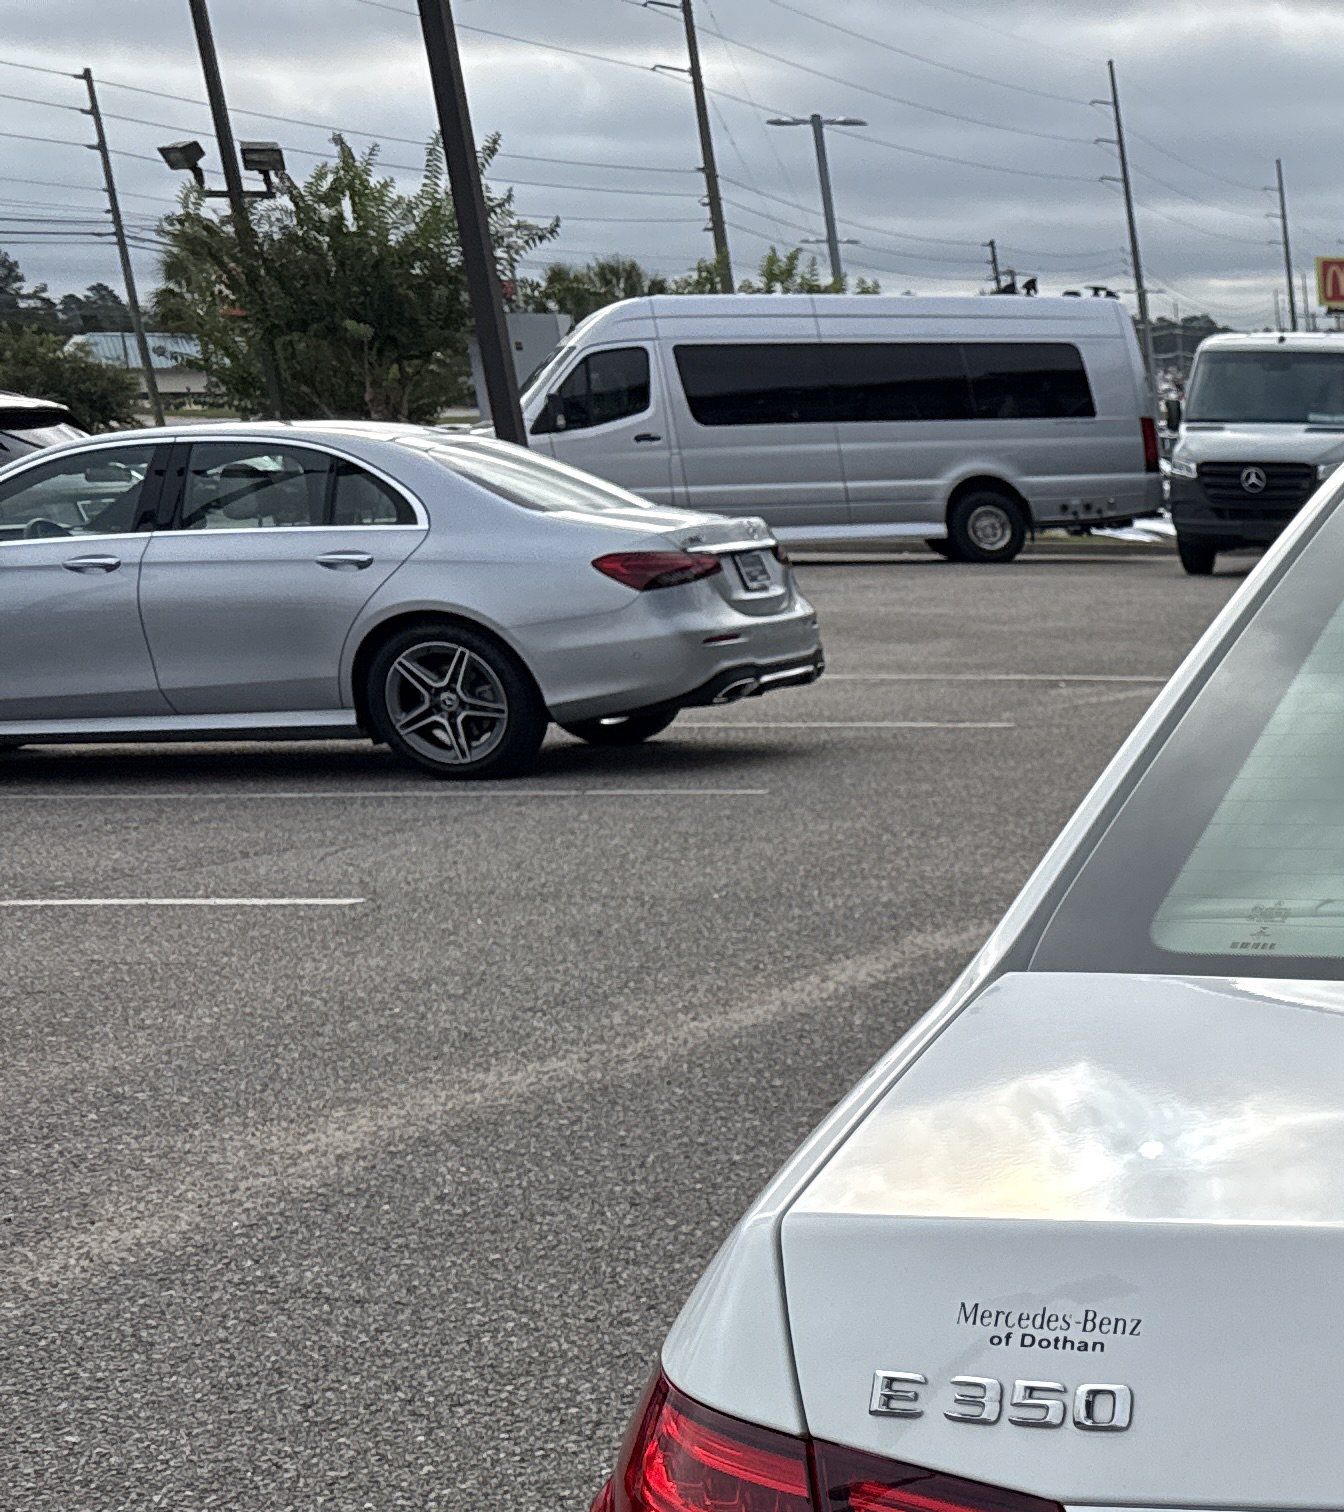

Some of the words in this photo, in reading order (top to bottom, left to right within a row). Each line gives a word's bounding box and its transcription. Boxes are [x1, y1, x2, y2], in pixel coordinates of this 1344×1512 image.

[956, 1302, 1143, 1337] Mercedes-Benz
[989, 1333, 1014, 1347] of
[1020, 1333, 1106, 1353] Dothan
[868, 1369, 928, 1418] E
[943, 1375, 1136, 1433] 350
